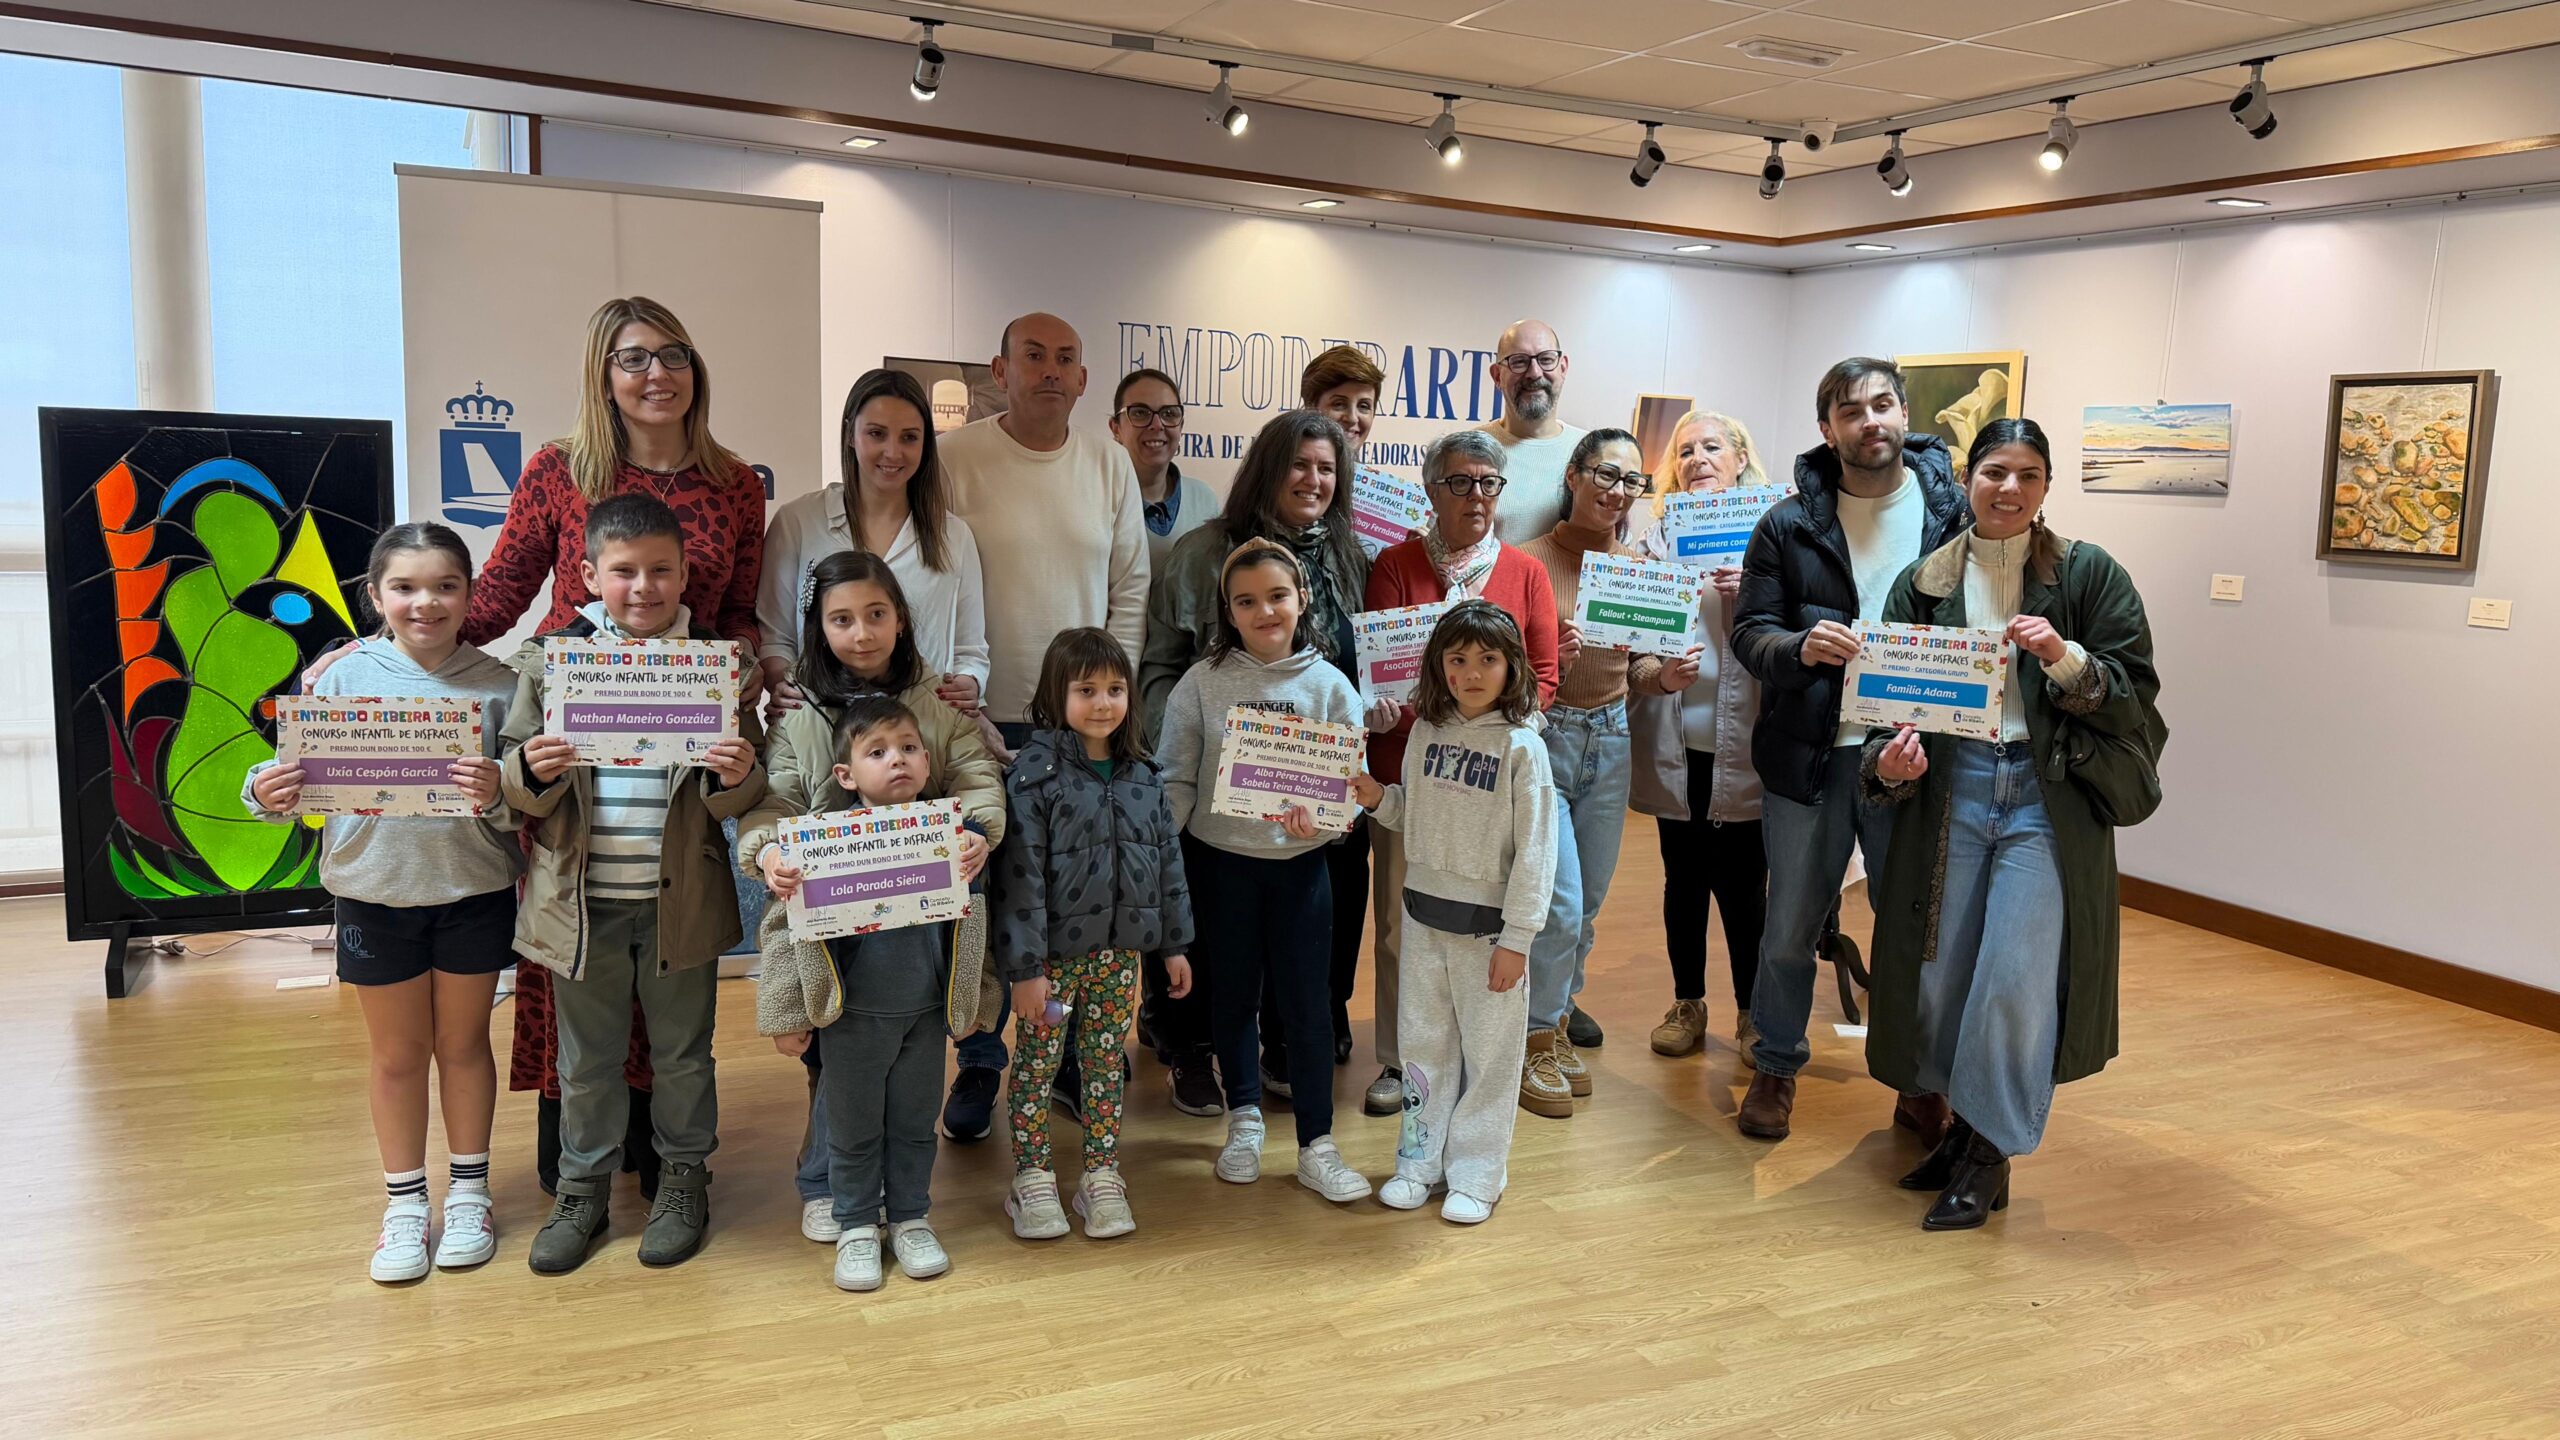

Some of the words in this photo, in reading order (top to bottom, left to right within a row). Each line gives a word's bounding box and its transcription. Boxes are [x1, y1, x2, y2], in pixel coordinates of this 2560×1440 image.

[1222, 435, 1243, 458] DE
[1367, 492, 1375, 500] DE
[1376, 495, 1403, 510] DISFRACES
[1370, 480, 1404, 498] RIBEIRA
[1406, 492, 1426, 505] 2026
[1673, 500, 1718, 511] ENTROIDO
[1721, 496, 1758, 507] RIBEIRA
[1693, 512, 1720, 521] CONCURSO
[1733, 509, 1761, 518] DISFRACES
[1371, 523, 1406, 540] Fernández
[1688, 541, 1697, 550] Mi
[1698, 540, 1728, 550] primera
[1591, 563, 1636, 577] ENTROIDO
[1639, 571, 1674, 583] RIBEIRA
[1676, 575, 1696, 586] 2026
[1608, 579, 1636, 590] CONCURSO
[1647, 586, 1675, 596] DISFRACES
[1363, 618, 1412, 633] ENTROIDO
[1416, 614, 1440, 625] RIBE
[1599, 609, 1625, 619] Fallout
[1633, 613, 1675, 626] Steampunk
[1387, 632, 1416, 644] CONCURSO
[1861, 633, 1918, 646] ENTROIDO
[1921, 637, 1967, 650] RIBEIRA
[1971, 642, 1998, 653] 2026
[559, 652, 632, 665] ENTROIDO
[637, 654, 693, 667] RIBEIRA
[697, 655, 726, 667] 2026
[1883, 649, 1918, 660] CONCURSO
[1933, 654, 1969, 665] DISFRACES
[568, 671, 612, 683] CONCURSO
[616, 671, 658, 684] INFANTIL
[662, 673, 672, 683] DE
[677, 673, 718, 684] DISFRACES
[1406, 669, 1415, 677] de
[1915, 667, 1946, 675] CATEGORÍA
[1886, 683, 1921, 695] Familia
[1923, 688, 1957, 699] Adams
[291, 710, 368, 722] ENTROIDO
[373, 711, 431, 722] RIBEIRA
[436, 711, 468, 723] 2026
[571, 712, 613, 724] Nathan
[617, 712, 662, 724] Maneiro
[665, 712, 716, 725] González
[301, 727, 347, 740] CONCURSO
[351, 728, 396, 739] INFANTIL
[399, 728, 411, 739] DE
[414, 728, 459, 739] DISFRACES
[1235, 720, 1290, 737] ENTROIDO
[1293, 727, 1336, 745] RIBEIRA
[1338, 736, 1359, 748] 2026
[1240, 736, 1272, 748] CONCURSO
[1274, 742, 1306, 755] INFANTIL
[1309, 748, 1318, 757] DE
[1320, 749, 1351, 762] DISFRACES
[1256, 754, 1277, 762] PREMIO
[1277, 756, 1290, 764] DUN
[1290, 758, 1307, 767] BONO
[326, 767, 353, 777] Uxía
[355, 767, 398, 779] Cespón
[401, 767, 439, 778] García
[1254, 768, 1274, 778] Alba
[1276, 769, 1298, 781] Pérez
[1300, 775, 1321, 786] Oujo
[1242, 778, 1270, 789] Sabela
[1272, 781, 1293, 792] Teira
[1294, 784, 1338, 800] Rodríguez
[792, 823, 862, 844] ENTROIDO
[865, 816, 918, 834] RIBEIRA
[921, 812, 951, 827] 2026
[803, 846, 844, 860] CONCURSO
[847, 838, 888, 854] INFANTIL
[891, 838, 901, 847] DE
[904, 831, 944, 846] DISFRACES
[829, 860, 855, 870] PREMIO
[857, 859, 871, 868] DUN
[872, 856, 892, 865] BONO
[903, 853, 915, 861] 100
[831, 885, 854, 897] Lola
[856, 880, 894, 894] Parada
[896, 873, 926, 887] Sieira
